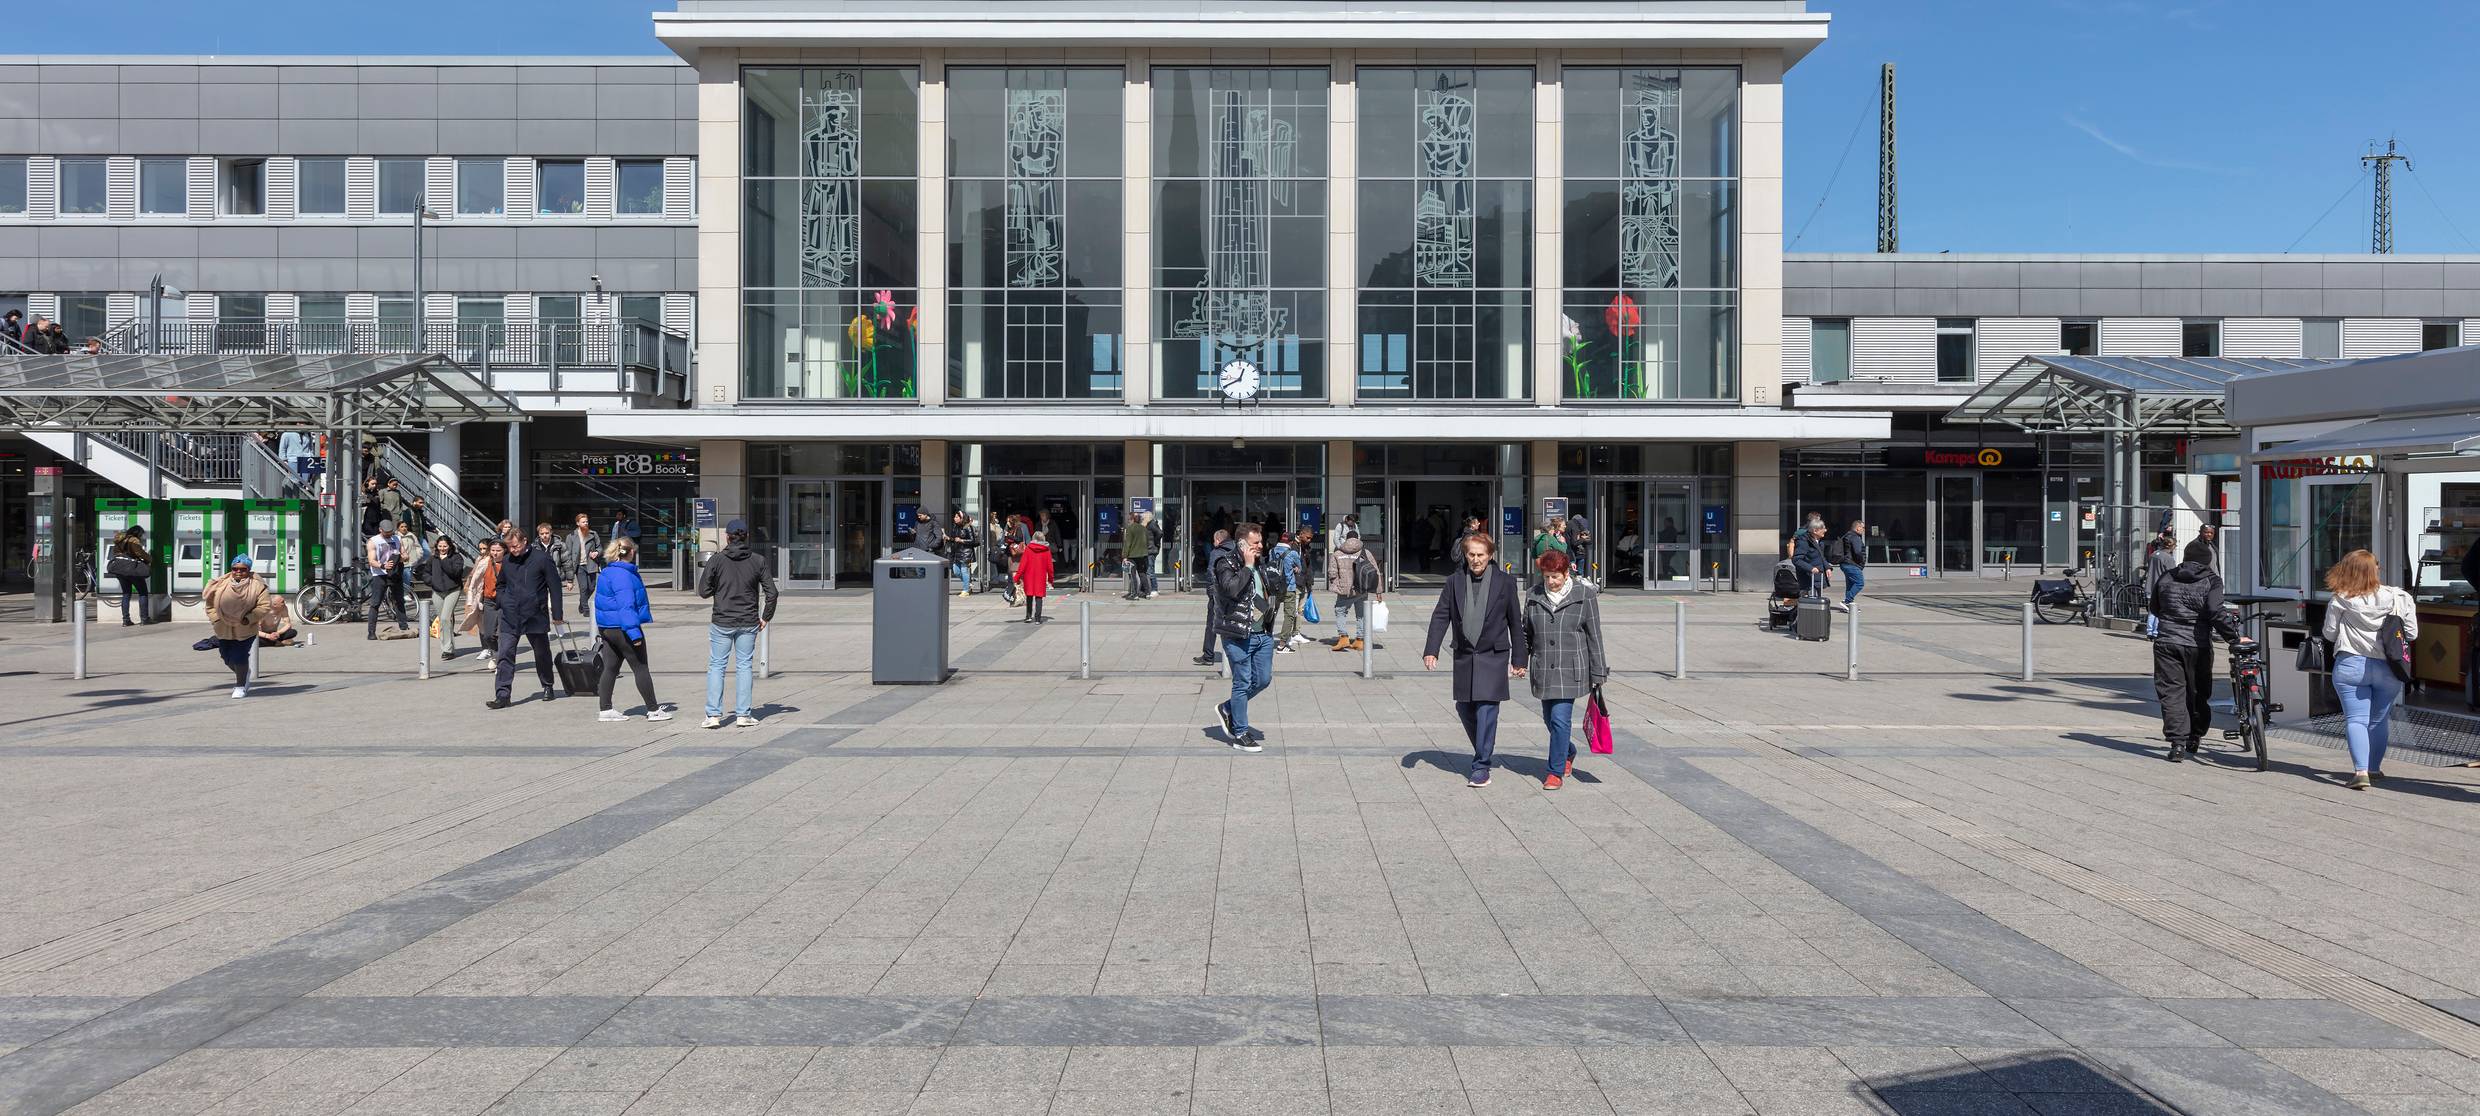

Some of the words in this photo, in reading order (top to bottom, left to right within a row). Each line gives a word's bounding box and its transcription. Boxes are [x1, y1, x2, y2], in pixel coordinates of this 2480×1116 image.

[582, 454, 608, 464] Press
[1925, 450, 1976, 467] Kamps
[615, 454, 653, 475] P&B
[655, 464, 686, 474] Books
[899, 511, 906, 520] U
[1101, 512, 1107, 520] U
[1303, 512, 1309, 521] U
[1505, 513, 1511, 521] U
[1707, 512, 1713, 520] U
